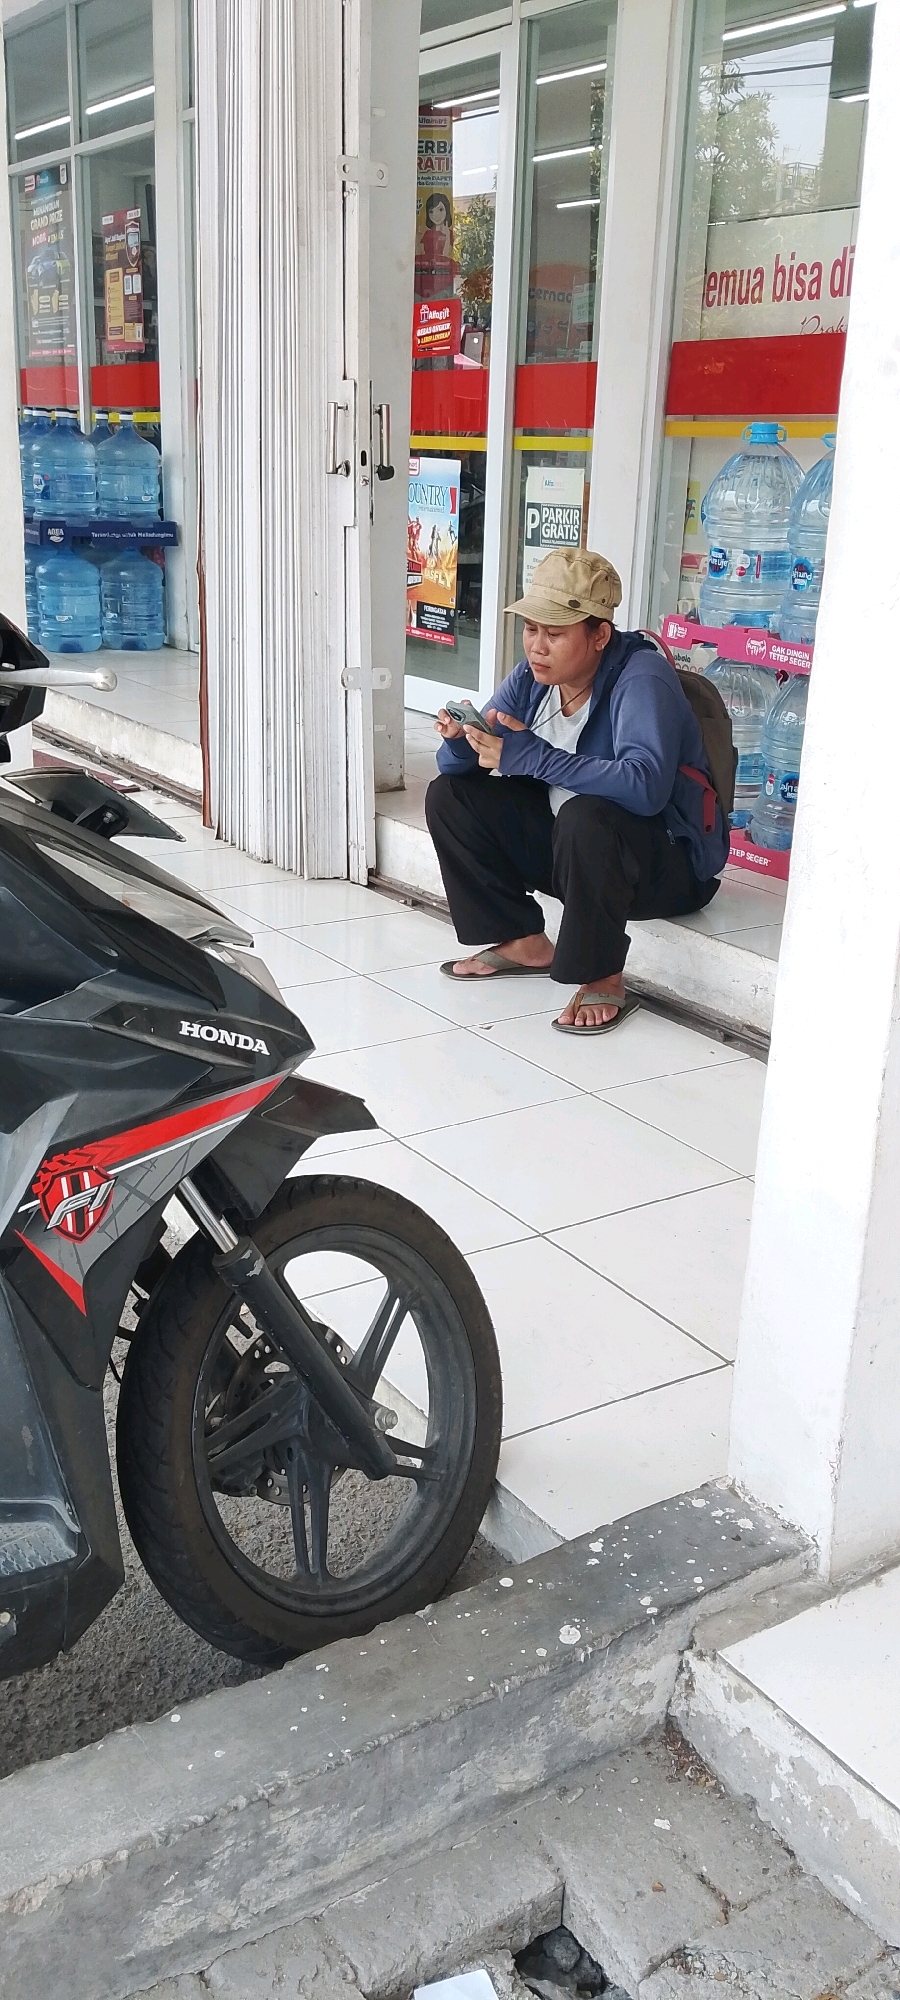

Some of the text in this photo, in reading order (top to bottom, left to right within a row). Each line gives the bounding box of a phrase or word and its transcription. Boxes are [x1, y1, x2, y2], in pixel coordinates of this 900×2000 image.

[418, 140, 453, 154] ERB
[417, 156, 453, 171] RATI
[31, 215, 49, 231] GRAND
[705, 266, 765, 308] emua
[772, 251, 823, 303] bisa
[409, 483, 449, 507] OUNTRY
[526, 507, 580, 539] P PARKIR
[541, 523, 579, 541] GRATIS
[769, 651, 811, 669] TETEP SEGER
[771, 644, 786, 655] GAK
[786, 648, 810, 661] DINGIN
[730, 846, 769, 867] ETEP SEGER
[179, 1020, 270, 1056] HONDA
